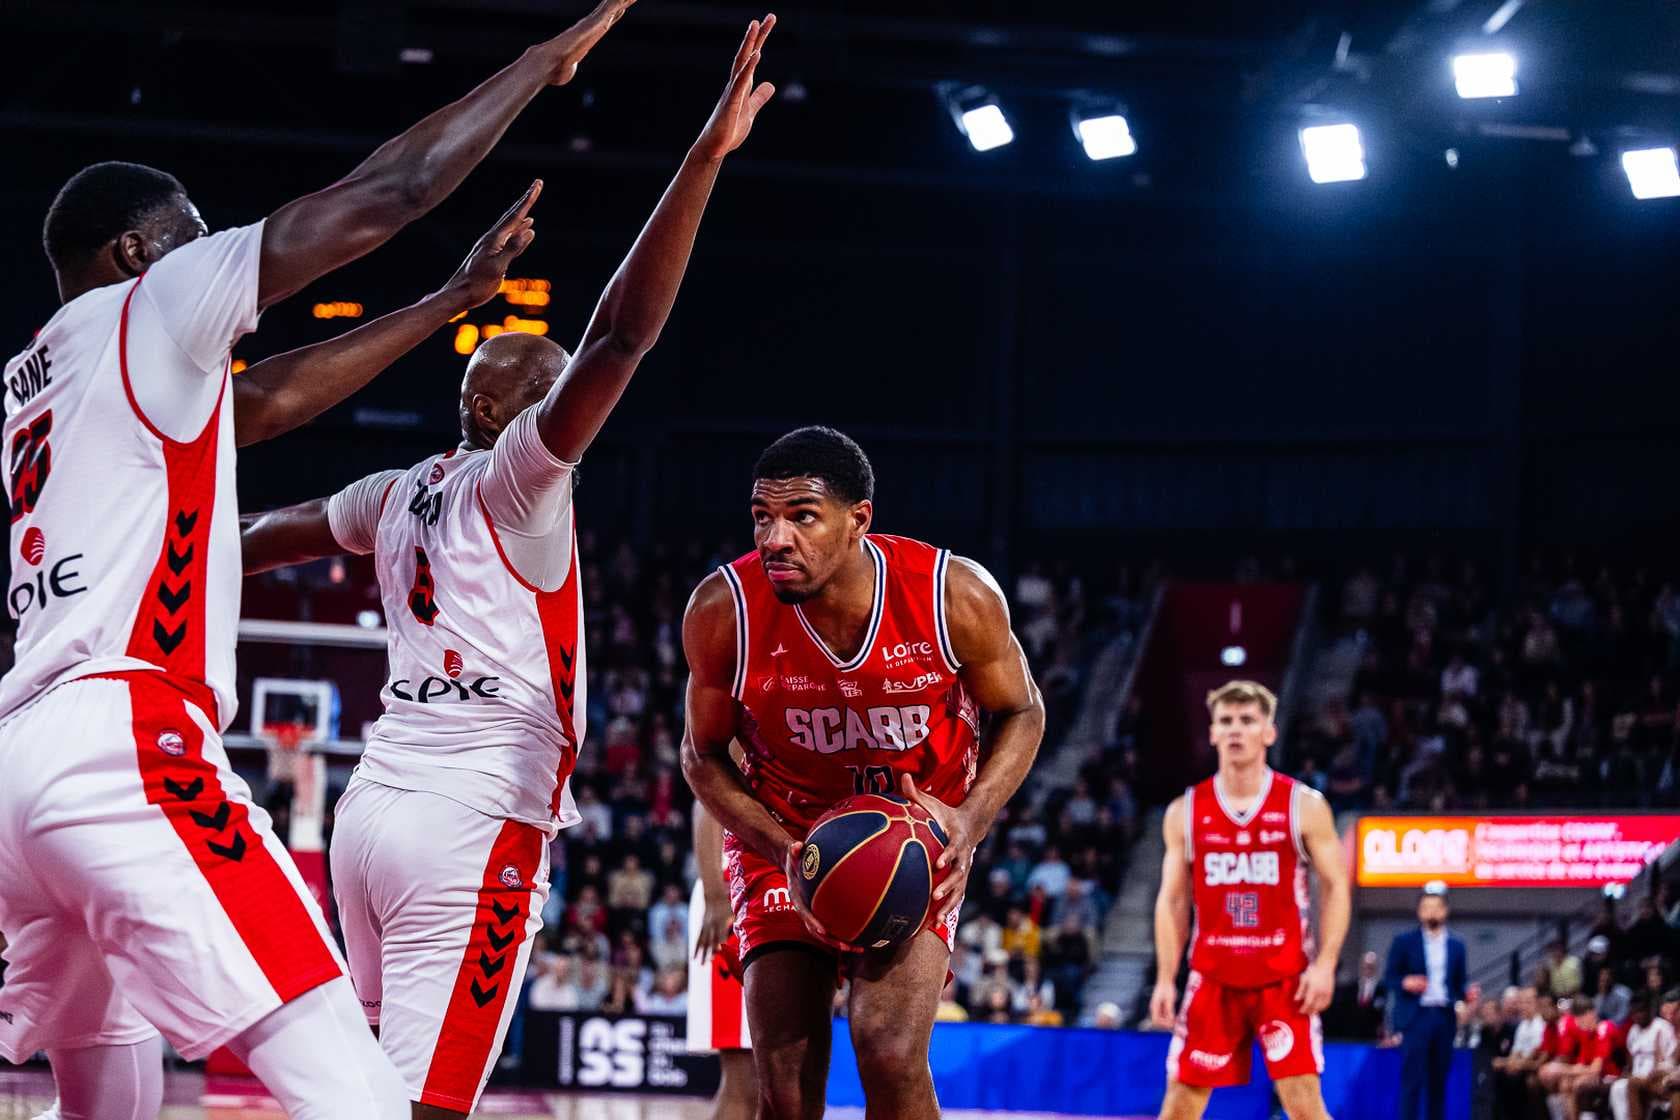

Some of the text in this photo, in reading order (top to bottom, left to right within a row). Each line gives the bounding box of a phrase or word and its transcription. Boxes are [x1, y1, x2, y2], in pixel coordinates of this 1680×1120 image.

[9, 345, 53, 406] SANE
[10, 553, 88, 617] PIE
[1203, 851, 1280, 886] SCABB
